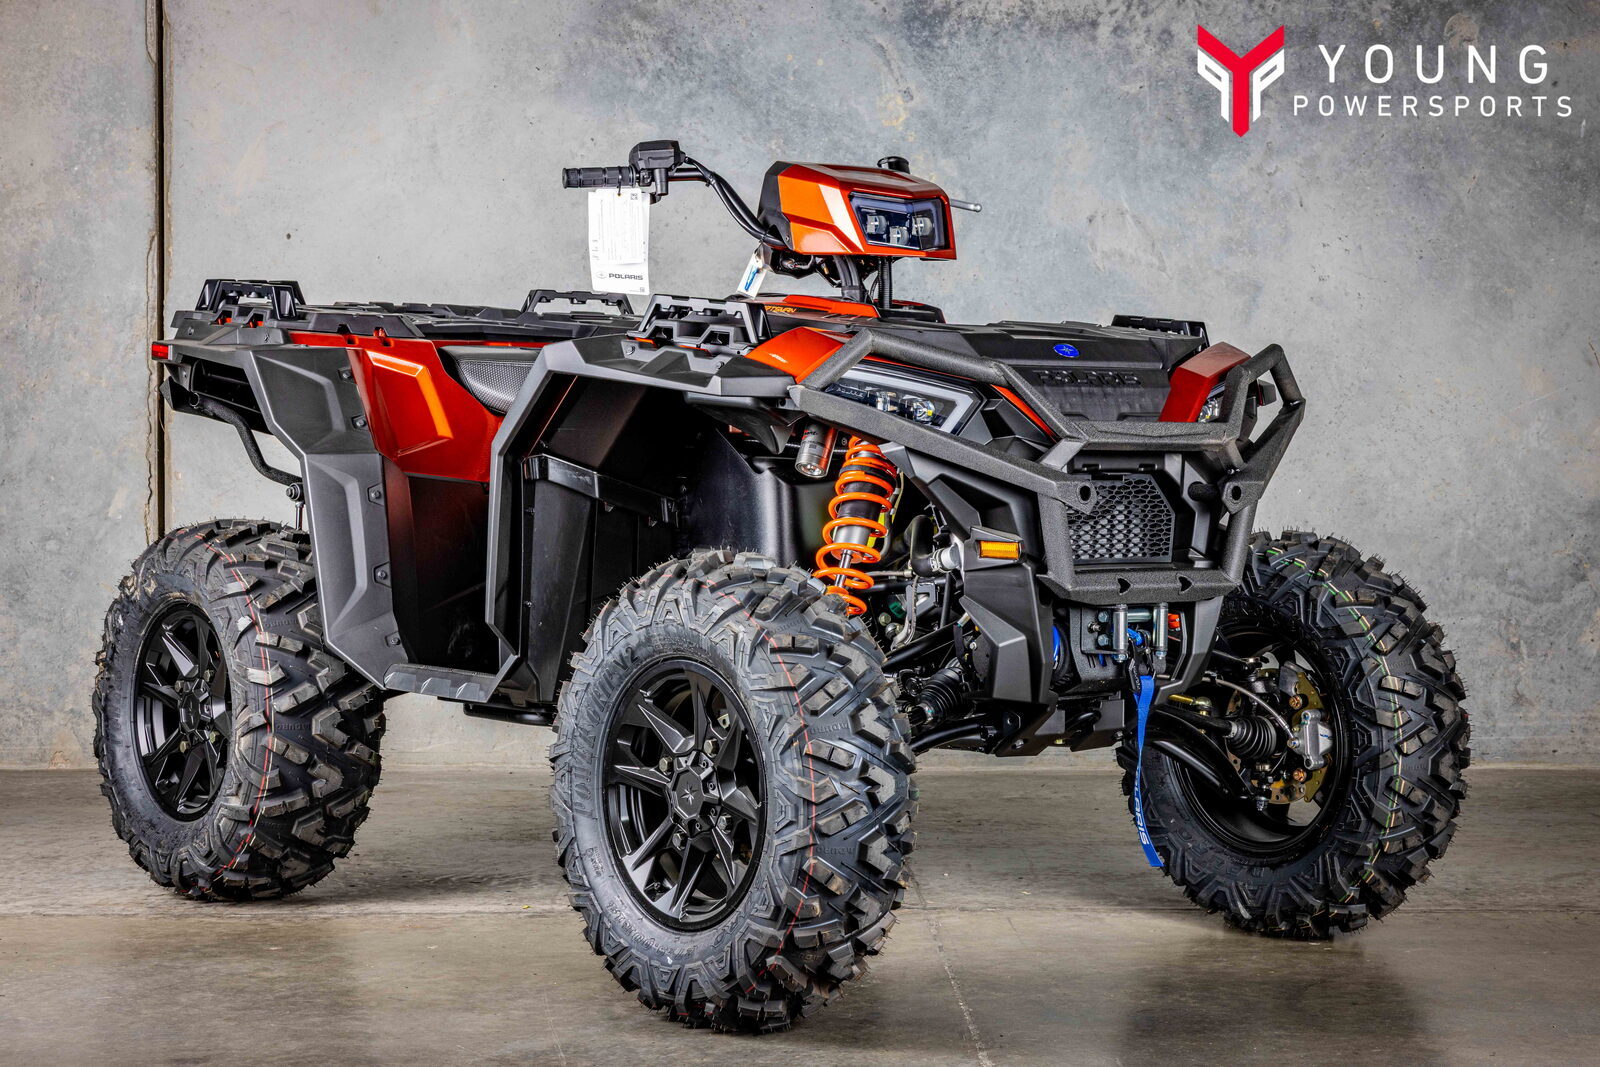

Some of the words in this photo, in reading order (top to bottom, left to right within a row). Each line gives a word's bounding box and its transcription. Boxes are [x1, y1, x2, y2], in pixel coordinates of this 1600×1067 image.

[608, 272, 644, 281] POLARIS
[764, 304, 797, 313] RTSMAN
[1032, 369, 1142, 387] POLARIS
[612, 646, 640, 672] V2
